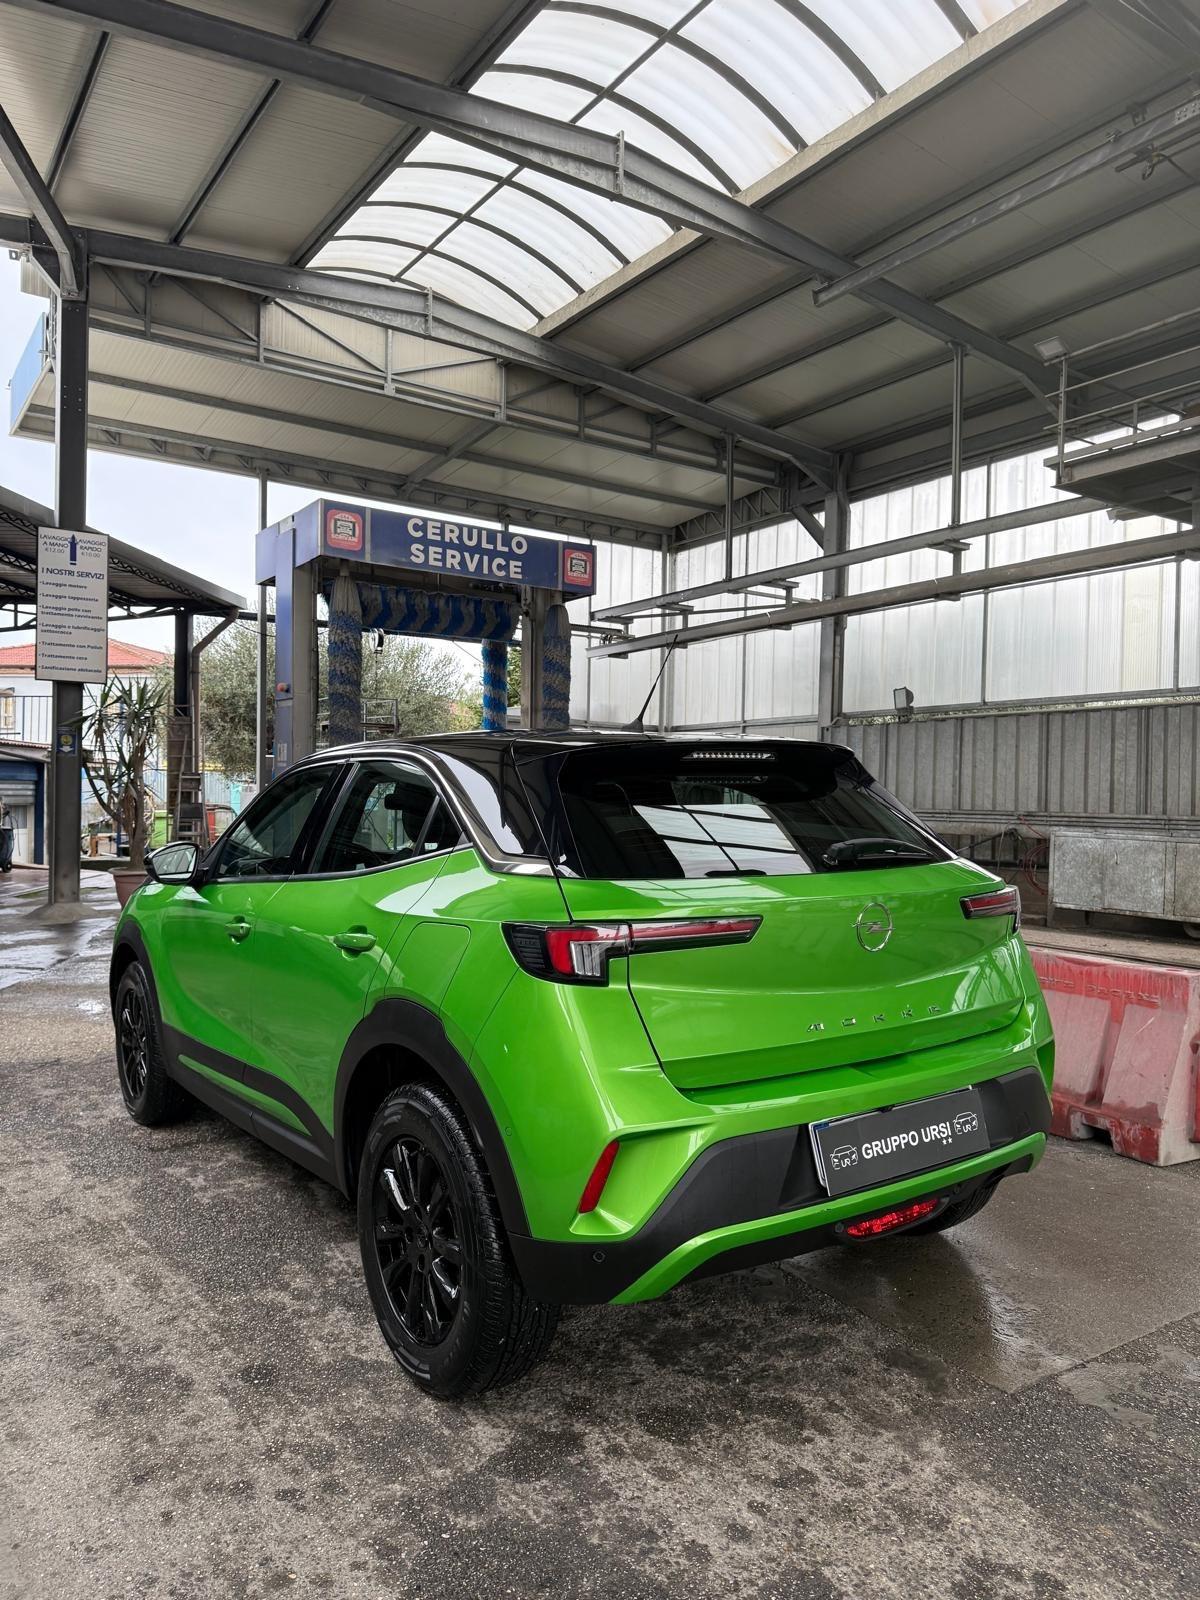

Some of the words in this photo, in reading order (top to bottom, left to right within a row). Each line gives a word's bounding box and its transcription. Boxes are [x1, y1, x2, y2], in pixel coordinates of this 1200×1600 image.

[406, 517, 528, 555] CERULLO
[46, 567, 75, 576] NOSTRI
[76, 570, 105, 579] SERVIZI
[409, 543, 523, 579] SERVICE
[861, 1130, 919, 1160] GRUPPO
[921, 1121, 952, 1143] URSI
